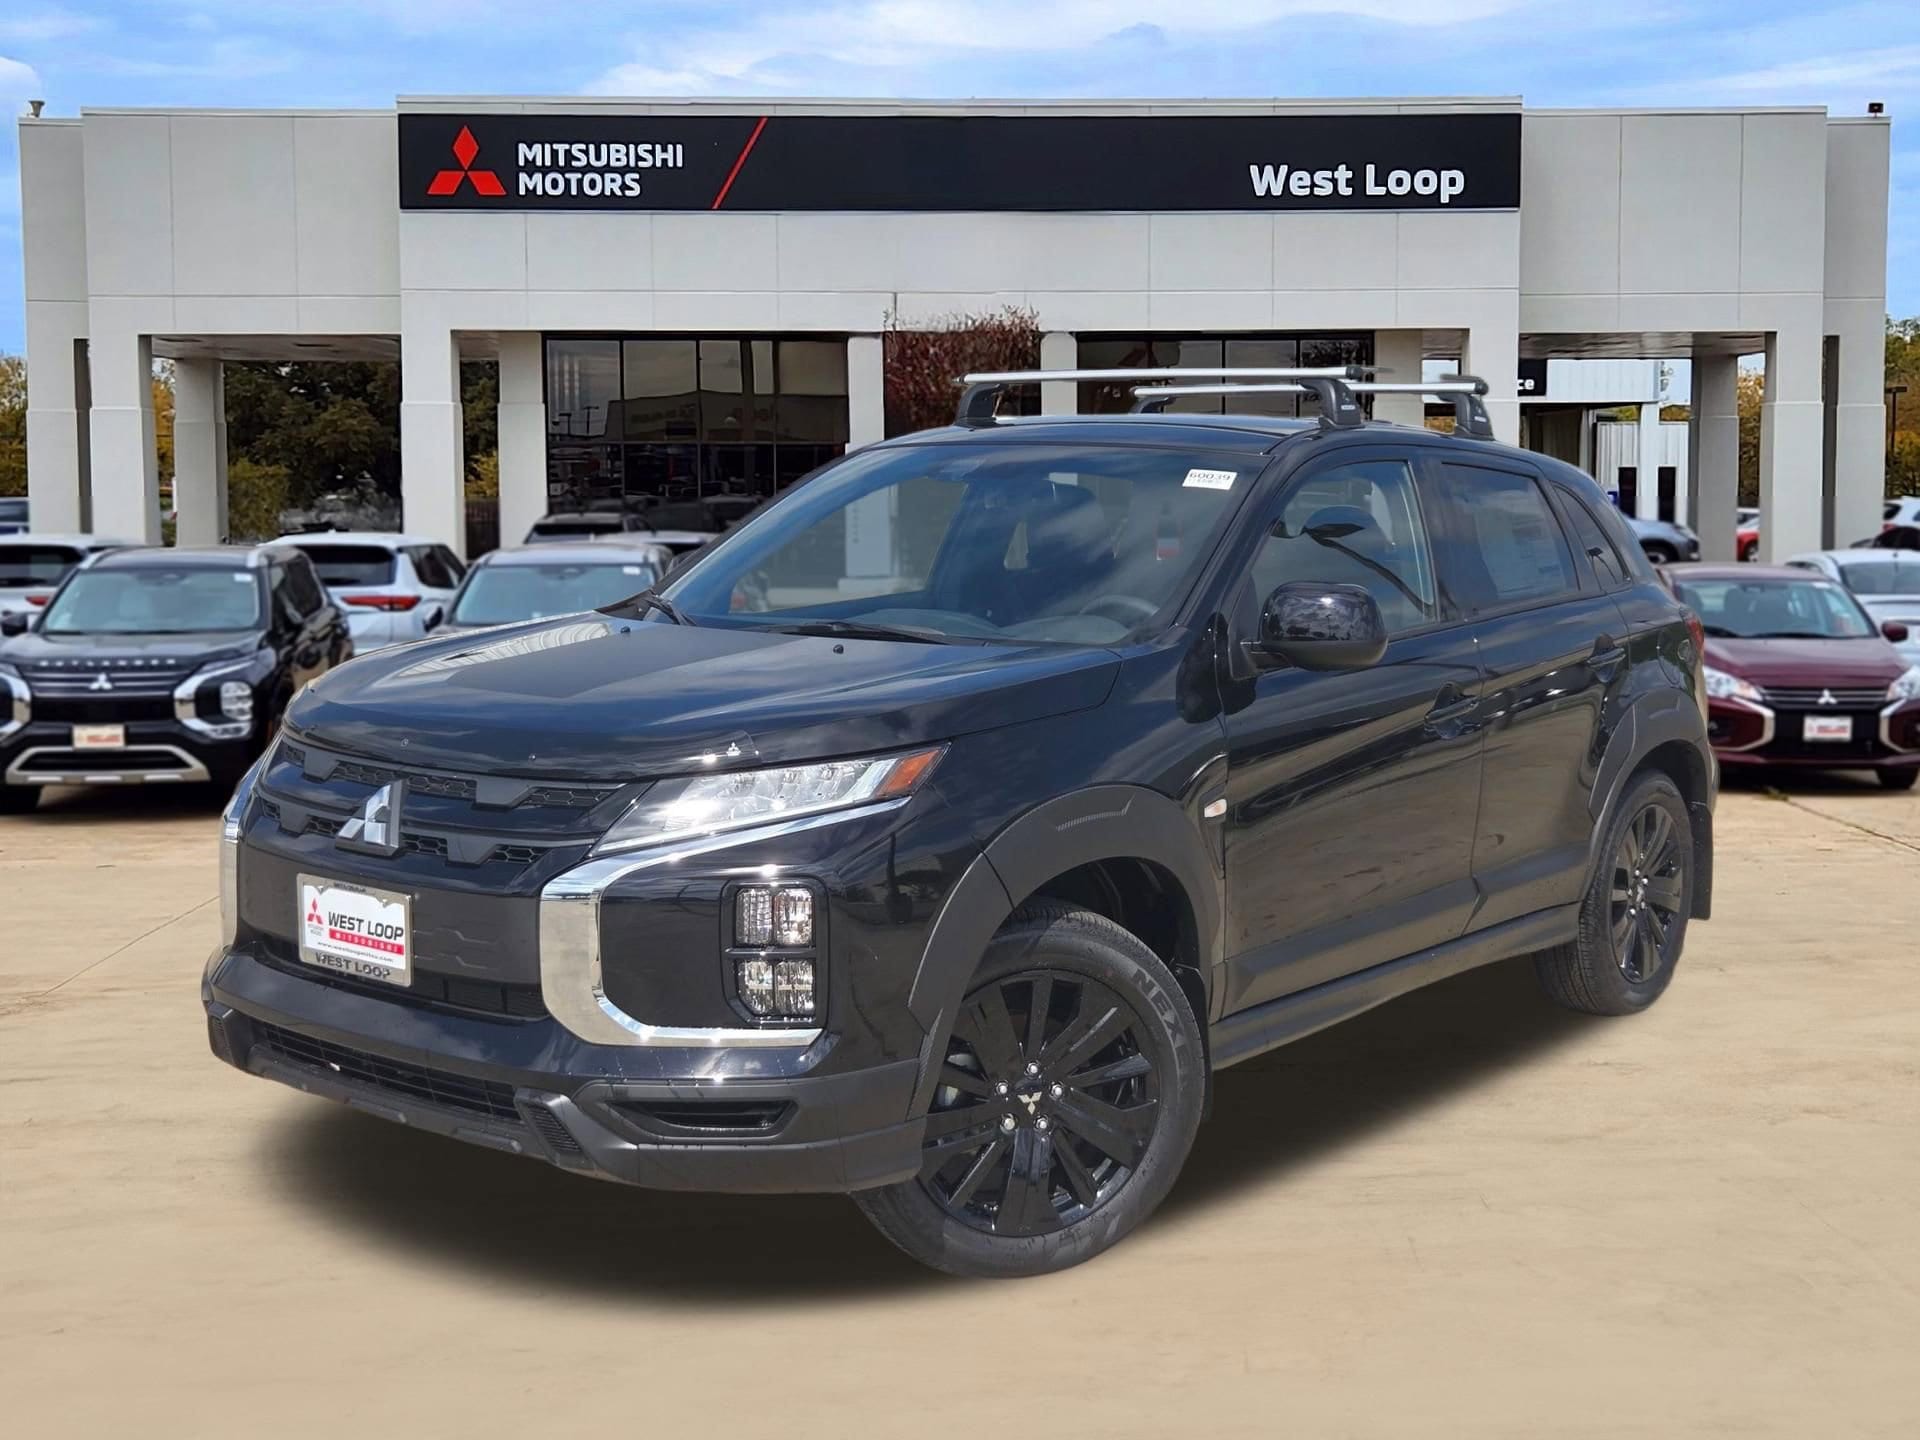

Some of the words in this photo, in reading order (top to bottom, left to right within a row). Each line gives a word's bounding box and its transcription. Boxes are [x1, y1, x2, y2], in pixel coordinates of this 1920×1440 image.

[517, 142, 684, 169] MITSUBISHI
[517, 171, 642, 197] MOTORS
[1248, 163, 1354, 197] West
[1365, 163, 1466, 204] Loop
[1517, 378, 1535, 391] ce
[328, 911, 365, 933] WEST
[367, 920, 404, 941] LOOP
[315, 950, 353, 970] WEST
[354, 961, 391, 979] LOOP
